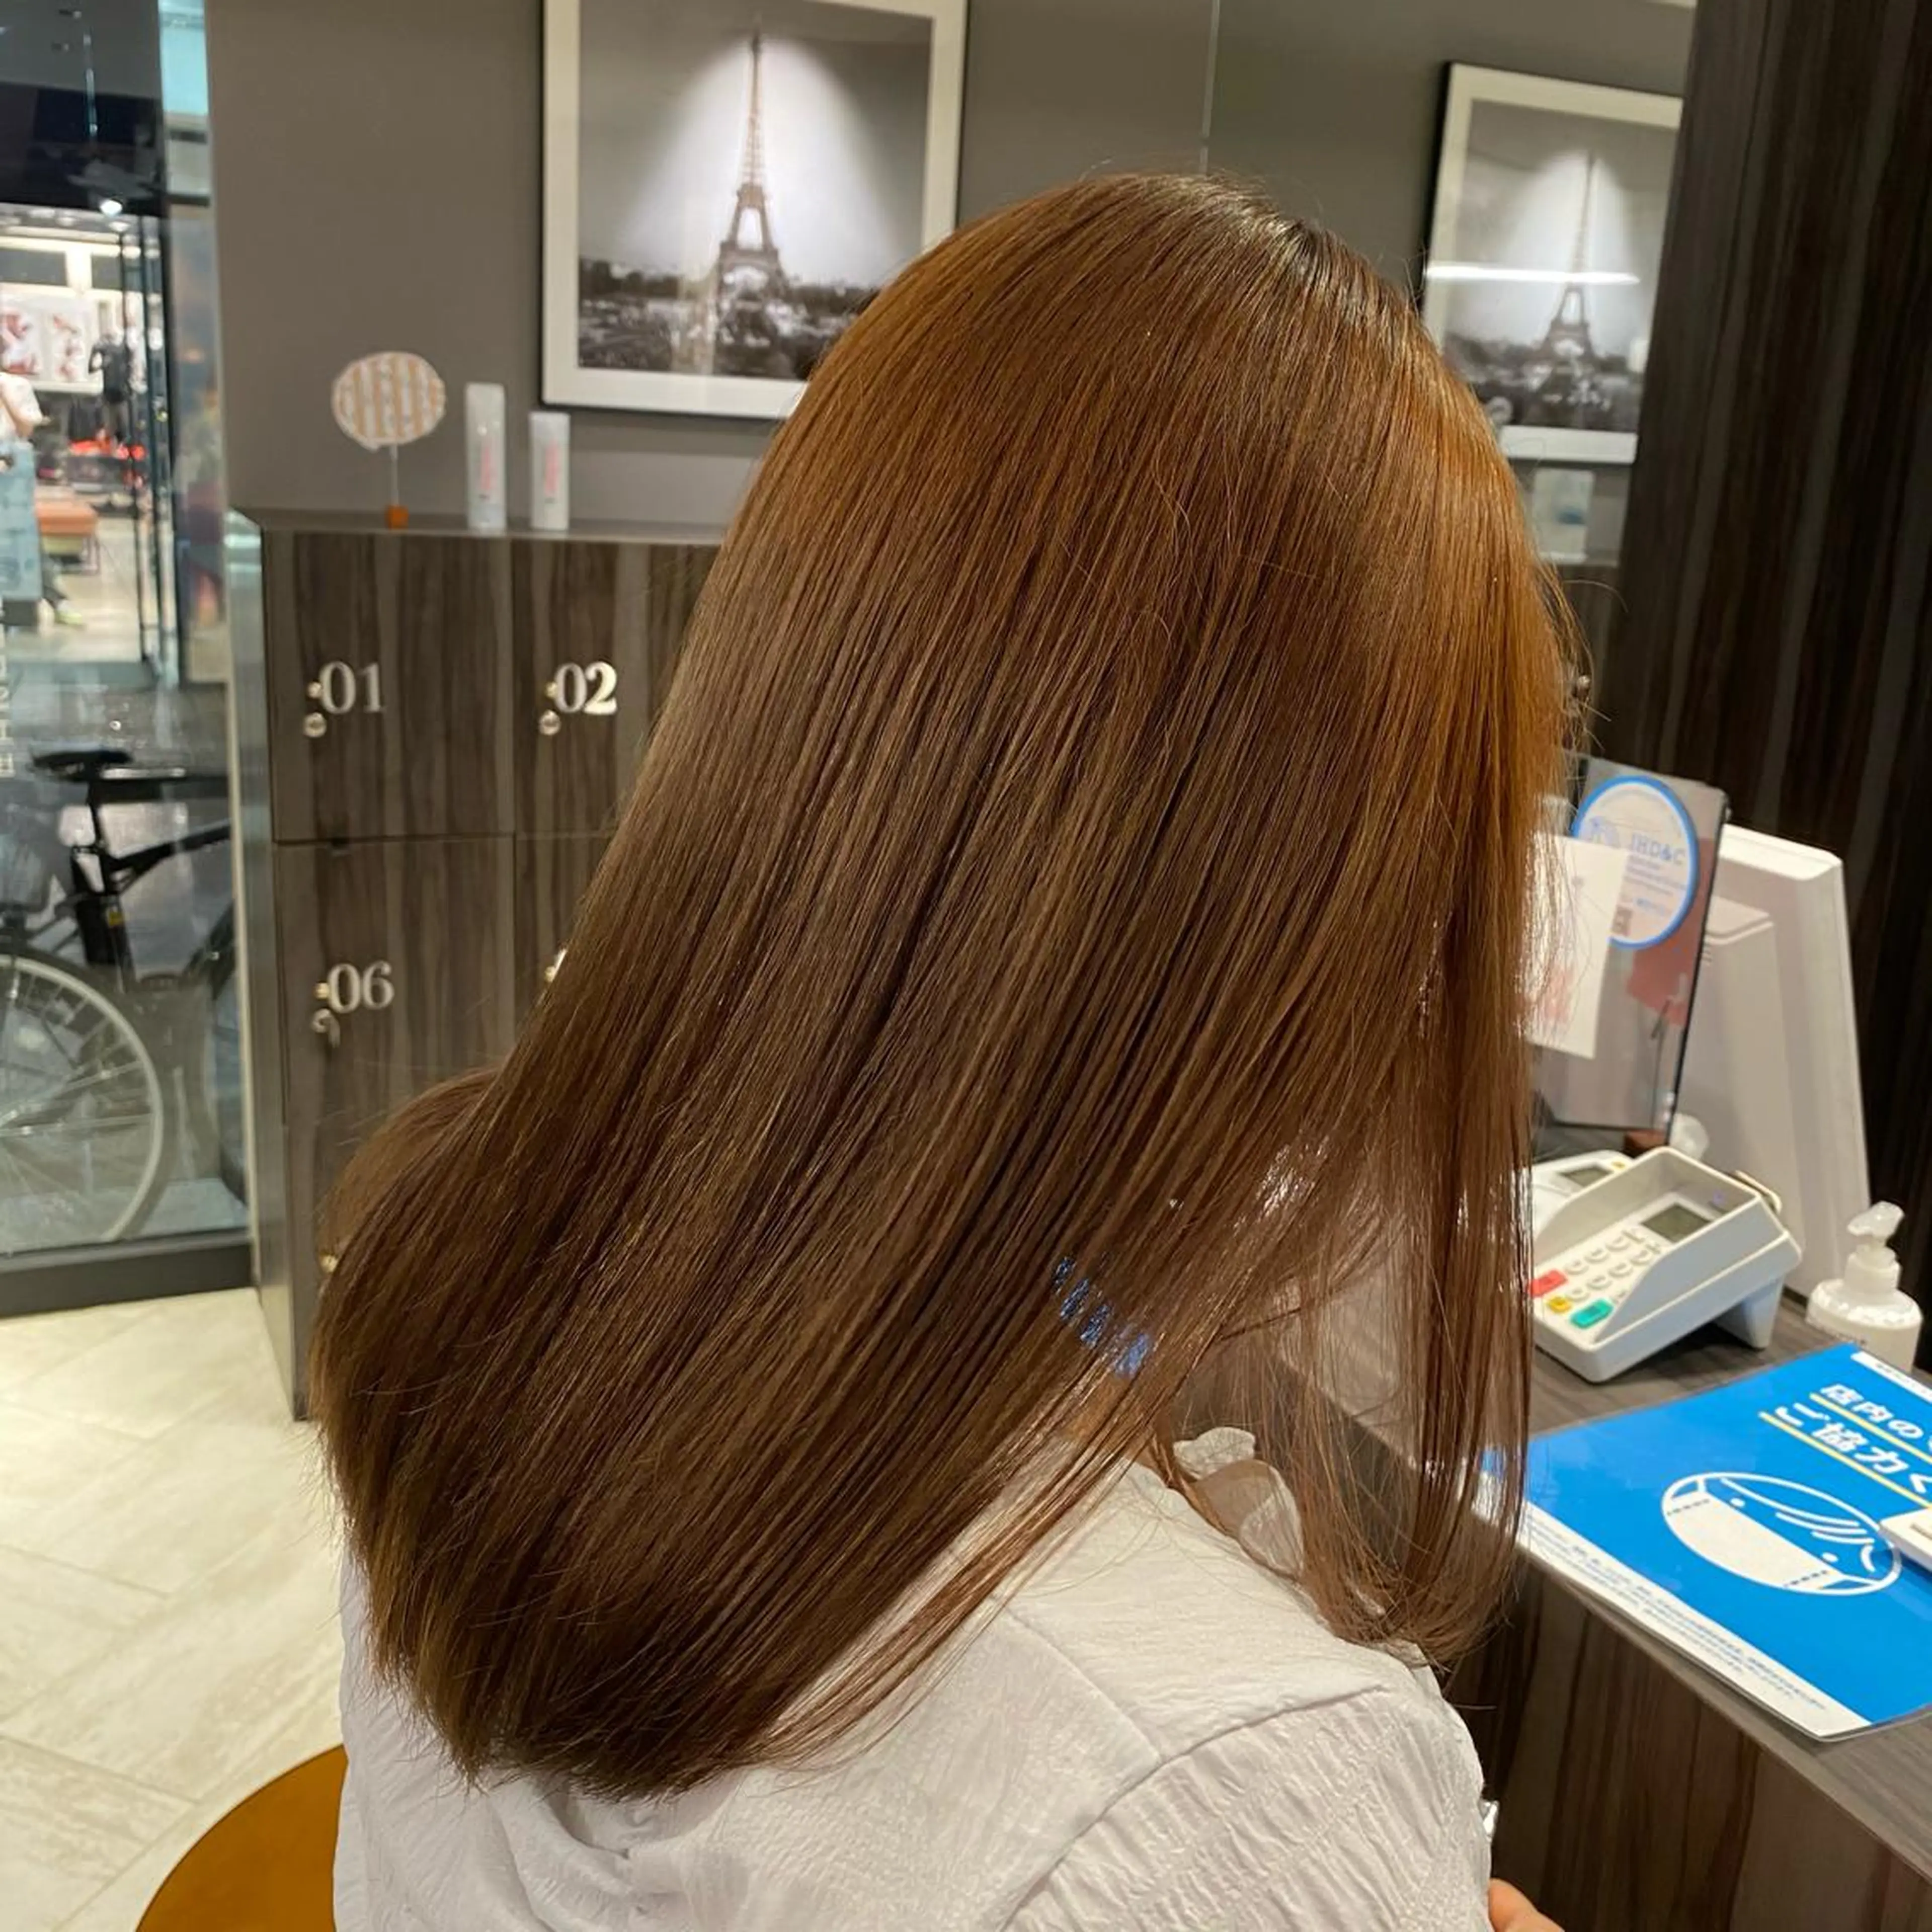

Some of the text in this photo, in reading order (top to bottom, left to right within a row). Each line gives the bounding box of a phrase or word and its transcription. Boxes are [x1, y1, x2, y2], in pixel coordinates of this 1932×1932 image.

[319, 660, 384, 715] 01
[553, 661, 618, 716] 02
[327, 960, 395, 1014] 06
[1819, 1383, 1932, 1453] 店内の
